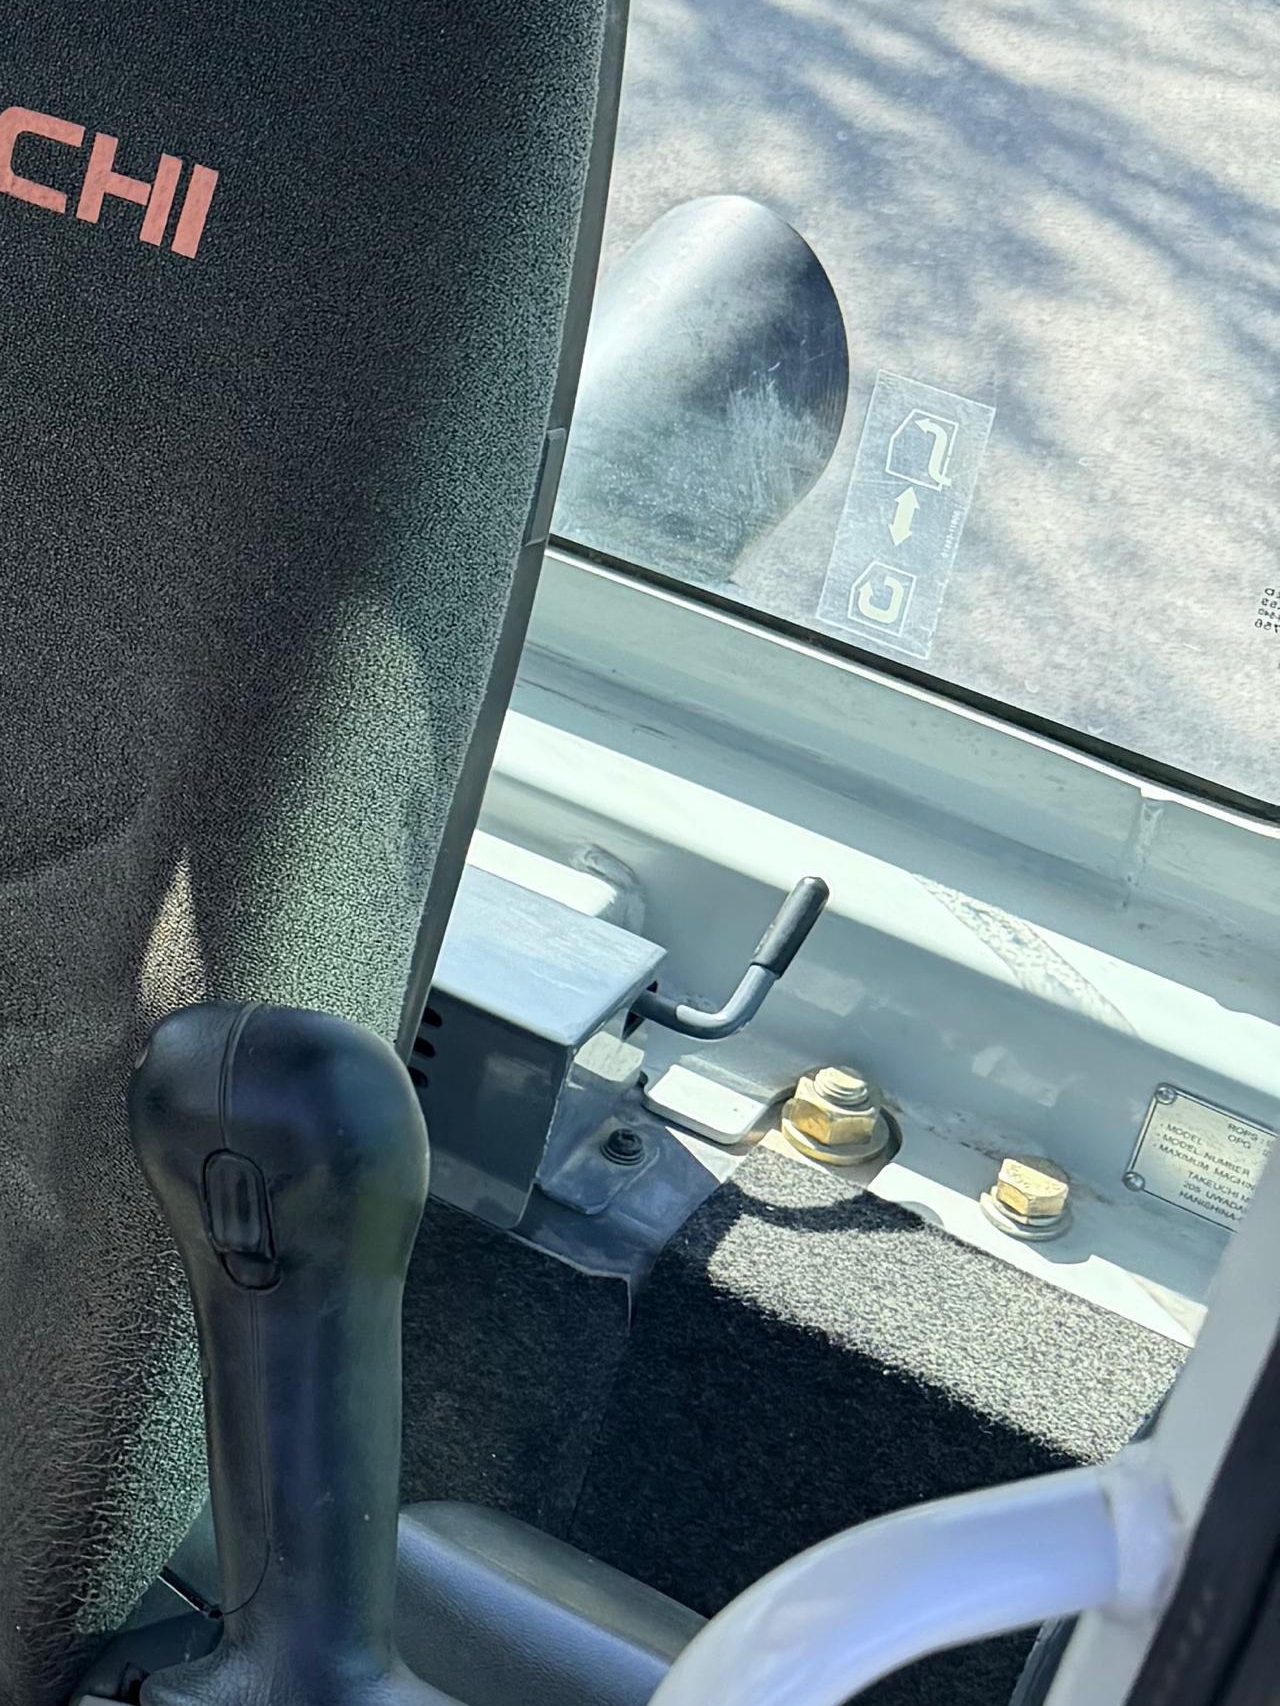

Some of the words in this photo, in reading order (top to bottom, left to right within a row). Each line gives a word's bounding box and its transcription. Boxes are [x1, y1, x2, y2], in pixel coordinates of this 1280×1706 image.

[1167, 1123, 1203, 1145] MODEL
[1159, 1144, 1210, 1171] MAXIMUM
[1214, 1167, 1256, 1191] MACHIN
[1162, 1134, 1200, 1155] MODEL
[1203, 1152, 1251, 1177] NUMBER
[1183, 1181, 1201, 1195] 205
[1206, 1191, 1247, 1214] UWADA
[1187, 1171, 1240, 1199] TAKEUCHI
[1179, 1190, 1243, 1222] HANISHINA-
